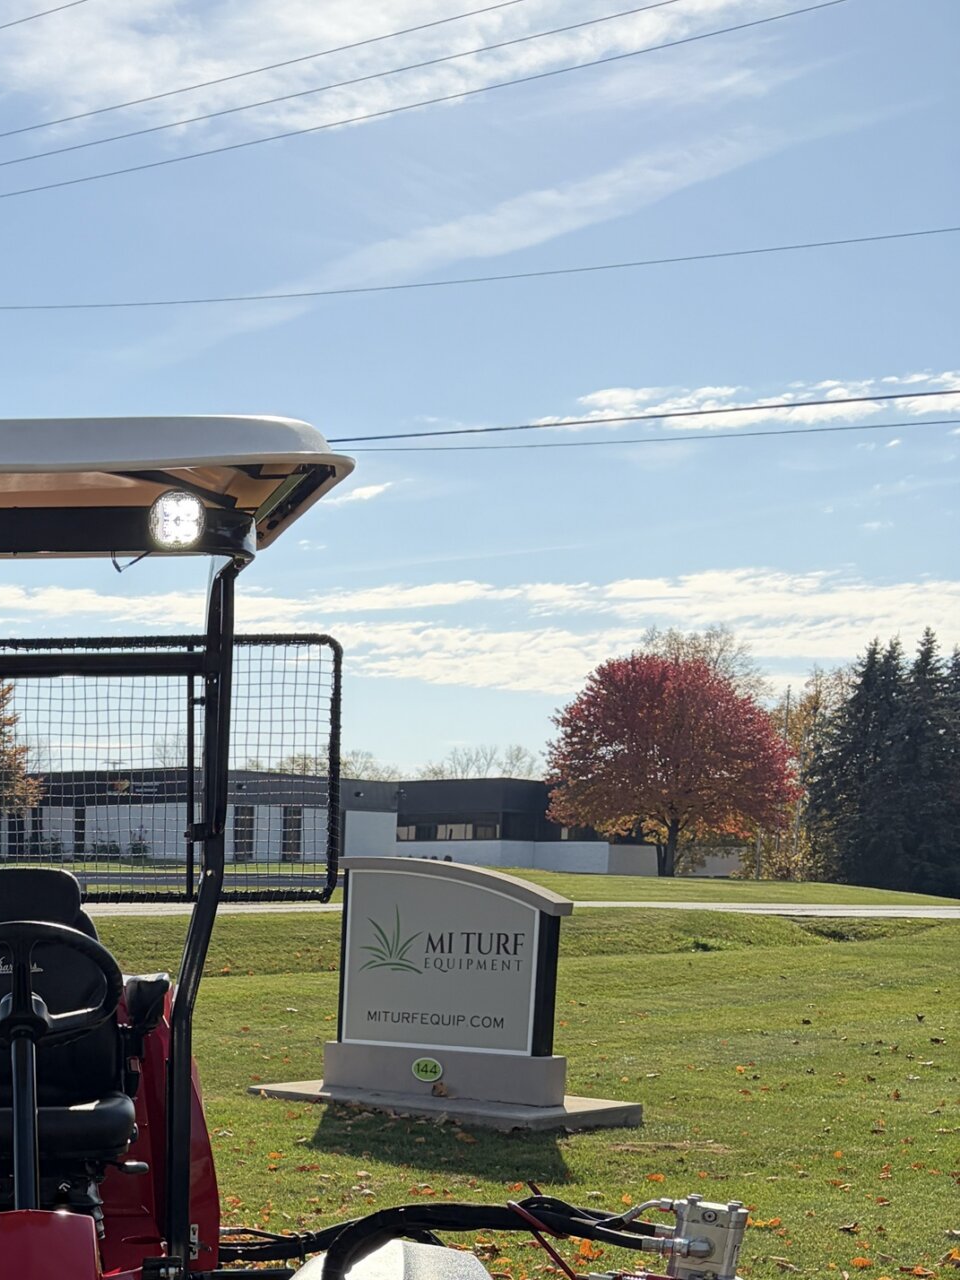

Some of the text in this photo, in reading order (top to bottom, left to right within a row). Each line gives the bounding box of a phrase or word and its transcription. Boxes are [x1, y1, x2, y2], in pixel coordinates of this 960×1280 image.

[425, 931, 526, 956] MI TURF
[424, 957, 524, 973] EQUIPMENT
[367, 1010, 505, 1029] MITURFEQUIP.COM
[416, 1062, 439, 1076] 144
